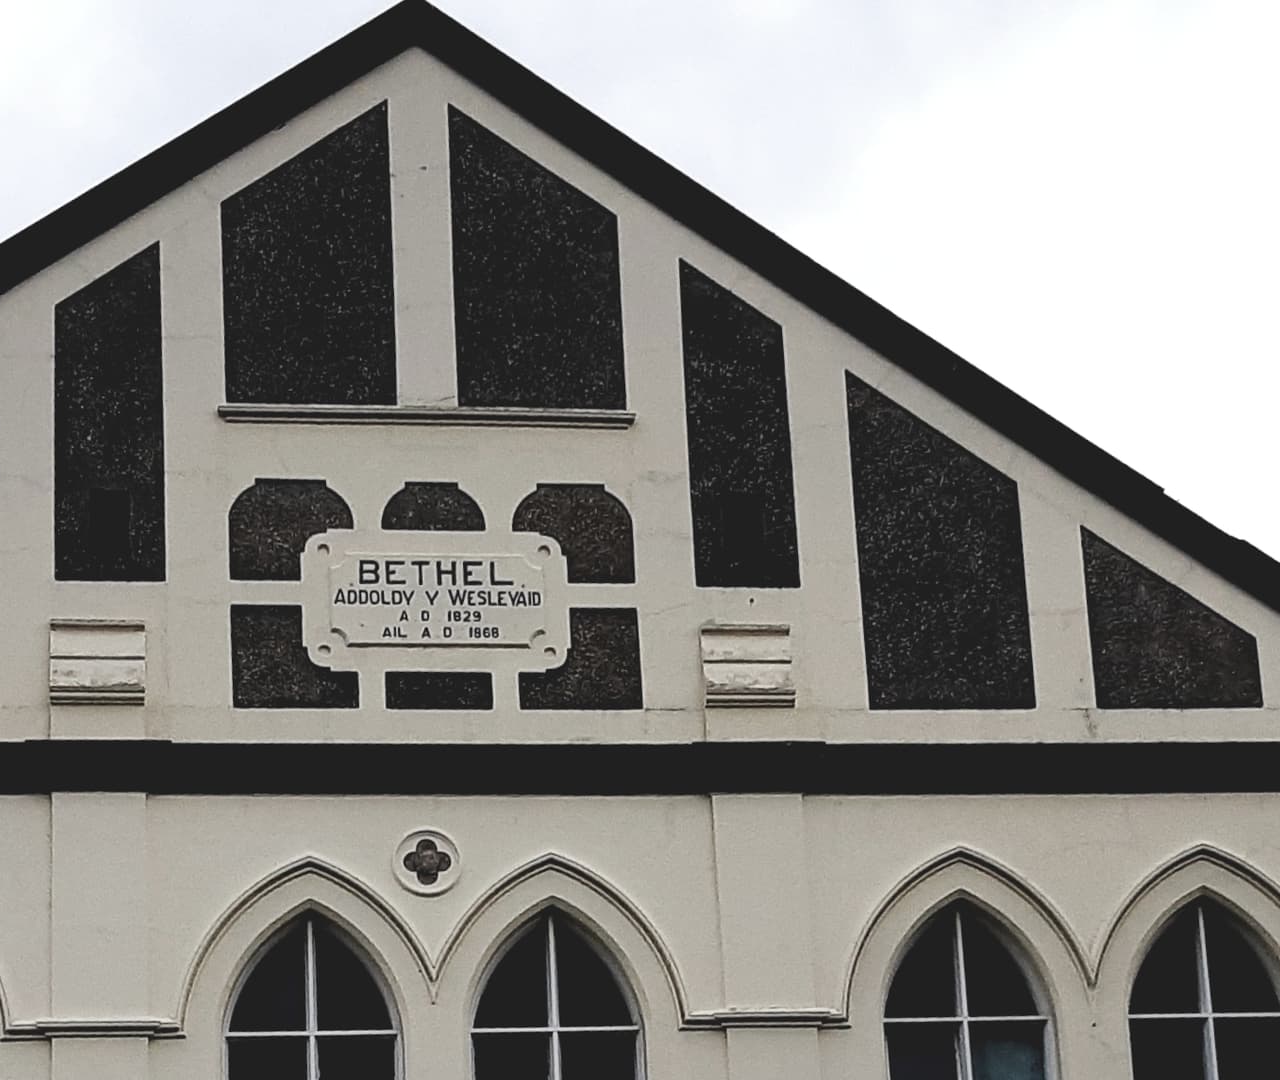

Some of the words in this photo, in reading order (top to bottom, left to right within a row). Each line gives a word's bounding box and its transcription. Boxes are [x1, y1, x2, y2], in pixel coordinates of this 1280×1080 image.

[334, 589, 415, 606] ADDOLDY
[425, 590, 439, 606] Y
[448, 589, 542, 607] WESLEYAID
[399, 610, 409, 622] A
[421, 610, 431, 622] D
[447, 610, 482, 622] 1829
[382, 627, 408, 638] AIL
[421, 627, 432, 638] A
[443, 627, 453, 639] D
[468, 627, 500, 639] 1868
